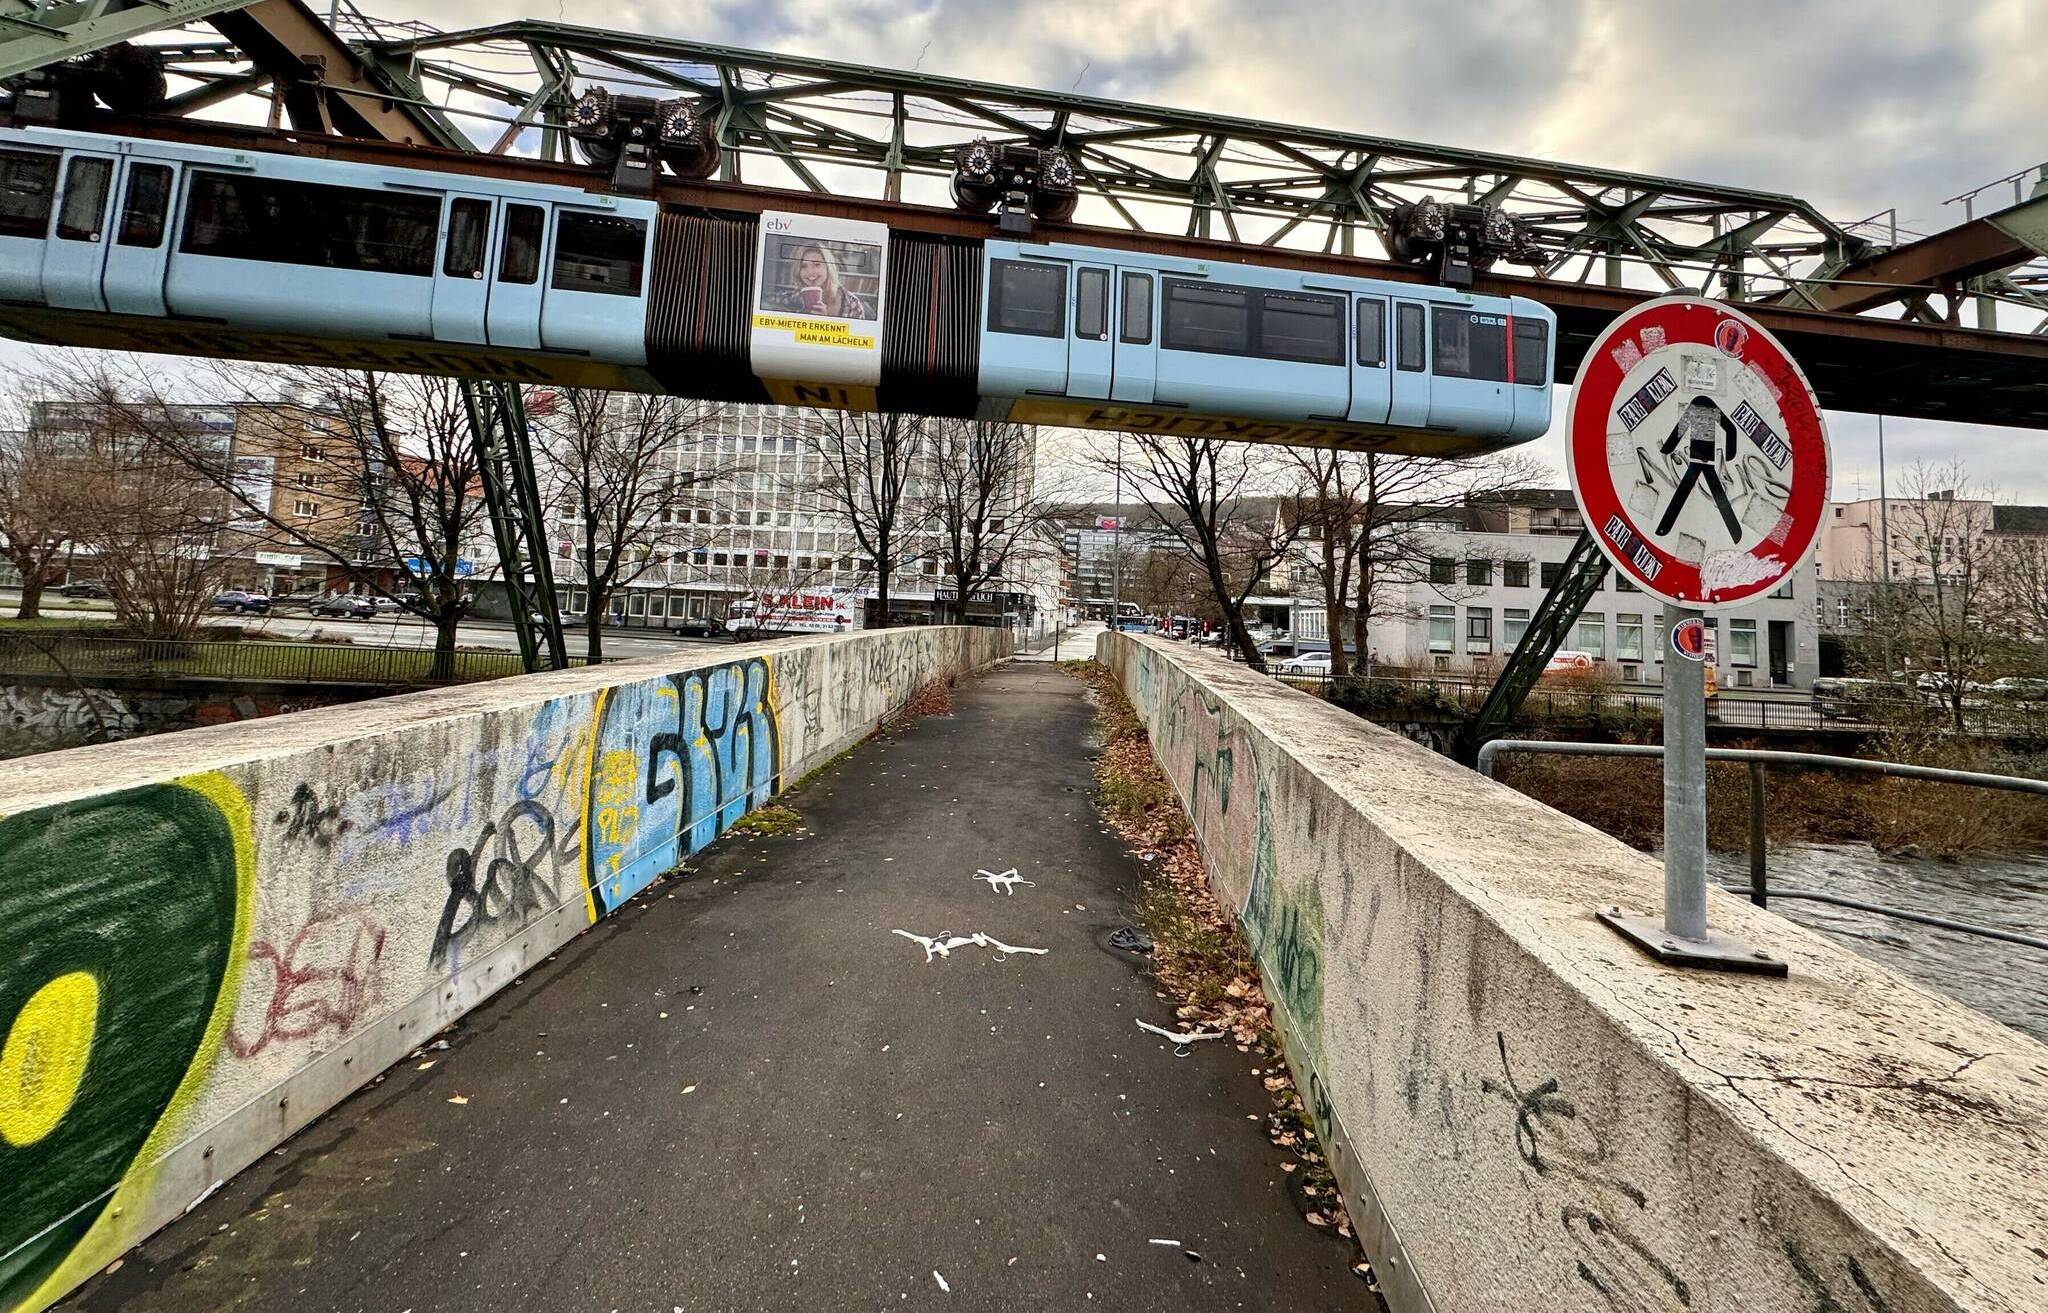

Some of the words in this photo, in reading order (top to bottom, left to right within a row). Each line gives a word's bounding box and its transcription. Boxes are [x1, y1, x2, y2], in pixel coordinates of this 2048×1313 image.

[759, 317, 807, 330] EBV-MIETER
[809, 323, 846, 333] ERKENNT
[800, 333, 817, 343] MAN
[819, 335, 830, 343] AM
[793, 385, 848, 405] IN
